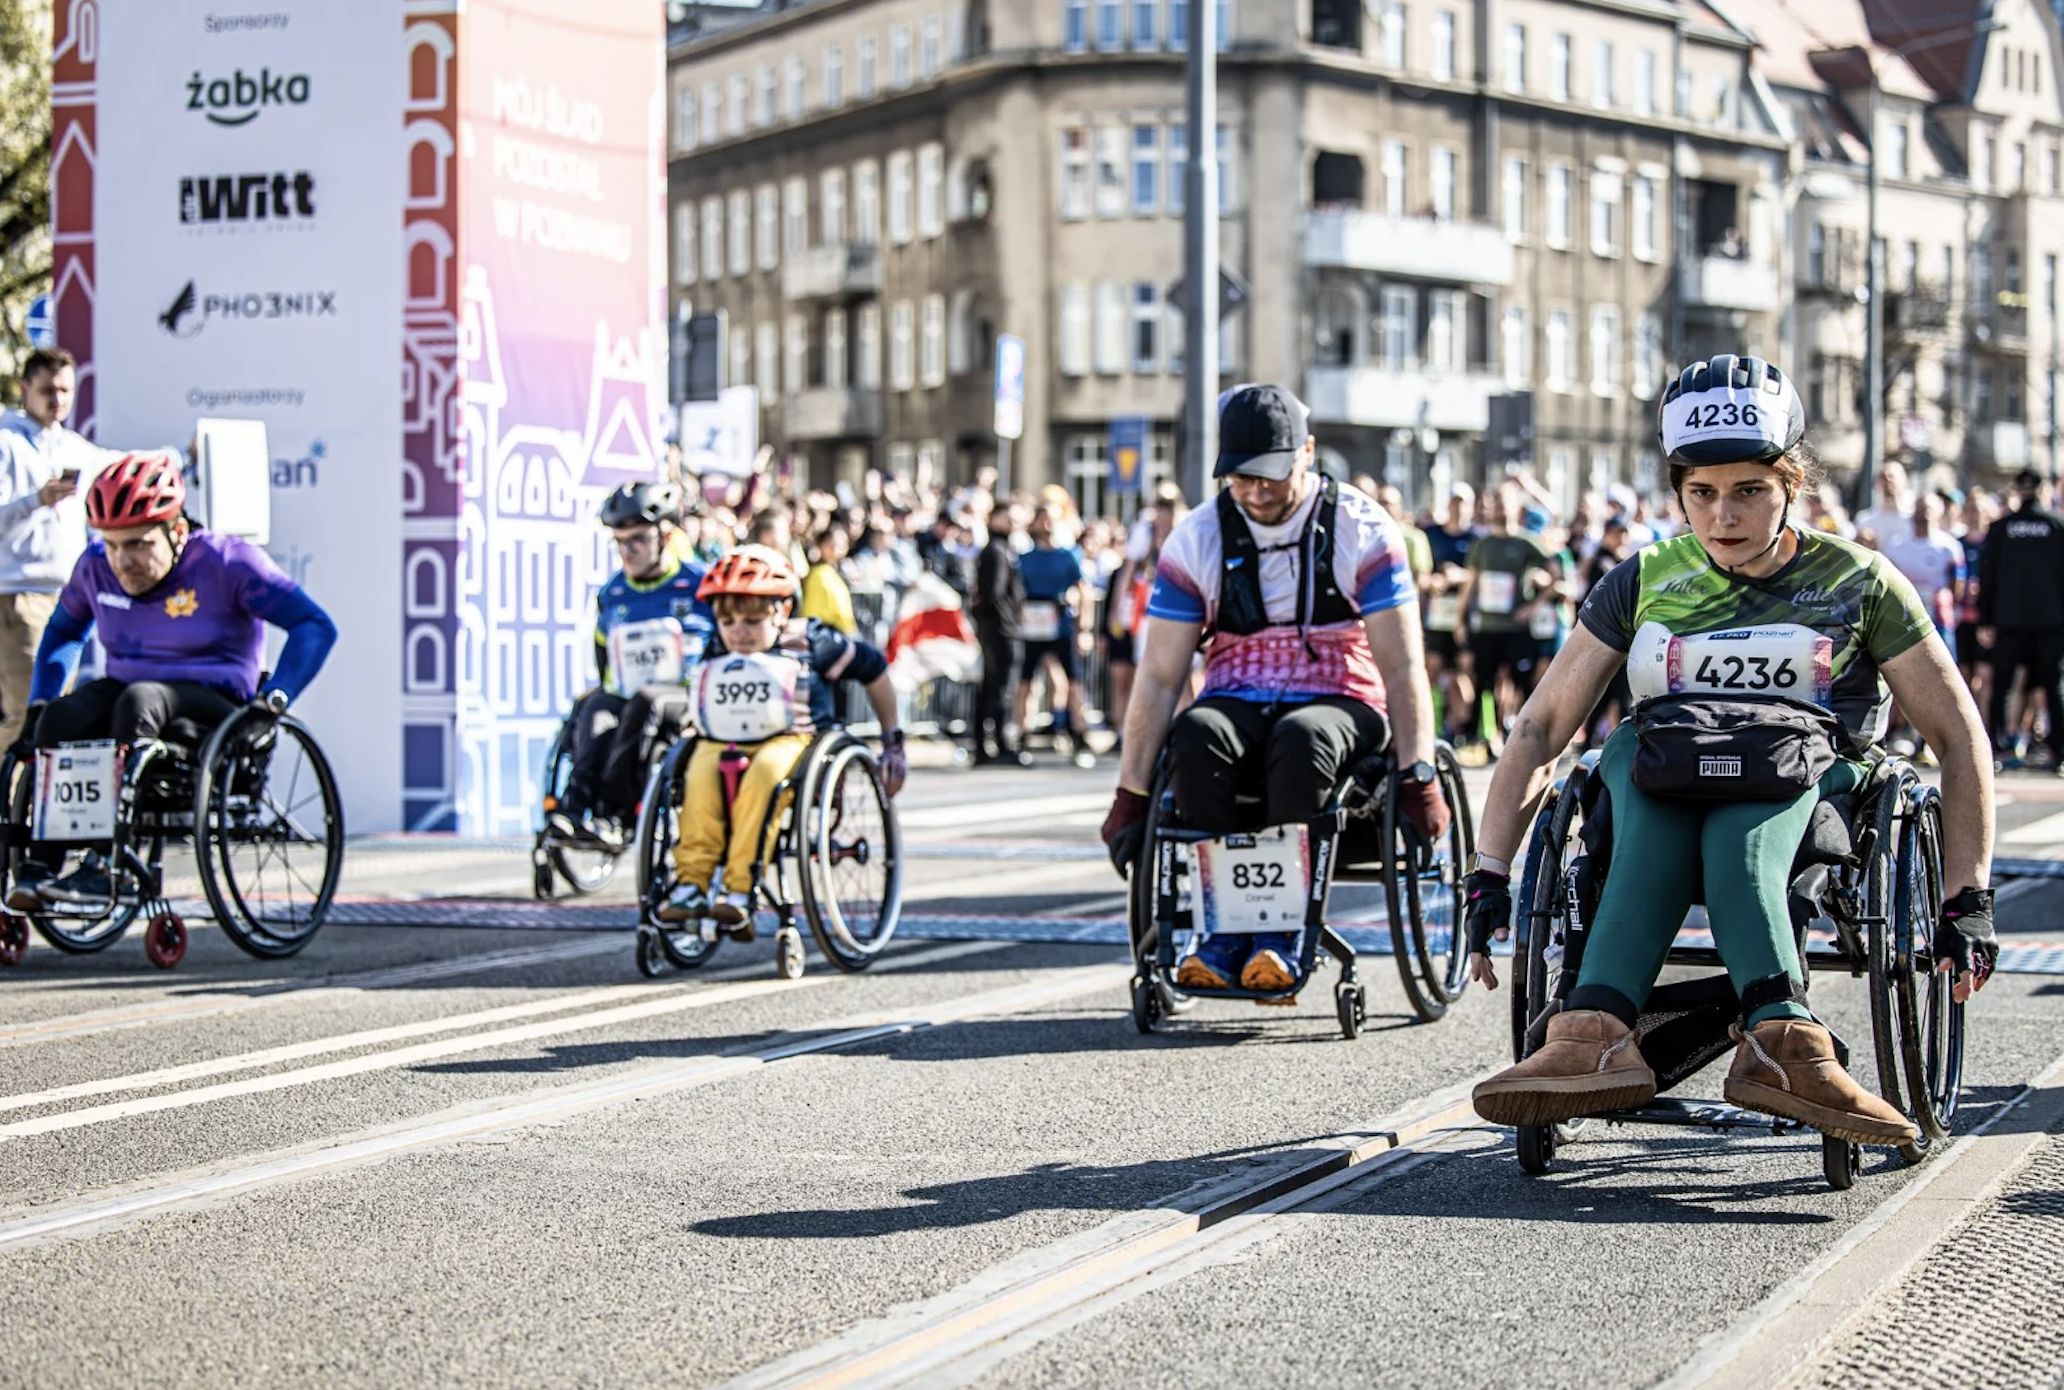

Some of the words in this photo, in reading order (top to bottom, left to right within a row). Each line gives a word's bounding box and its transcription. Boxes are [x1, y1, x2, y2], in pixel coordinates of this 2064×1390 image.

[185, 68, 310, 110] żabka
[1685, 403, 1758, 429] 4236
[1695, 655, 1798, 690] 4236
[715, 681, 771, 706] 3993
[1702, 762, 1739, 775] PUMA
[1232, 863, 1286, 889] 832
